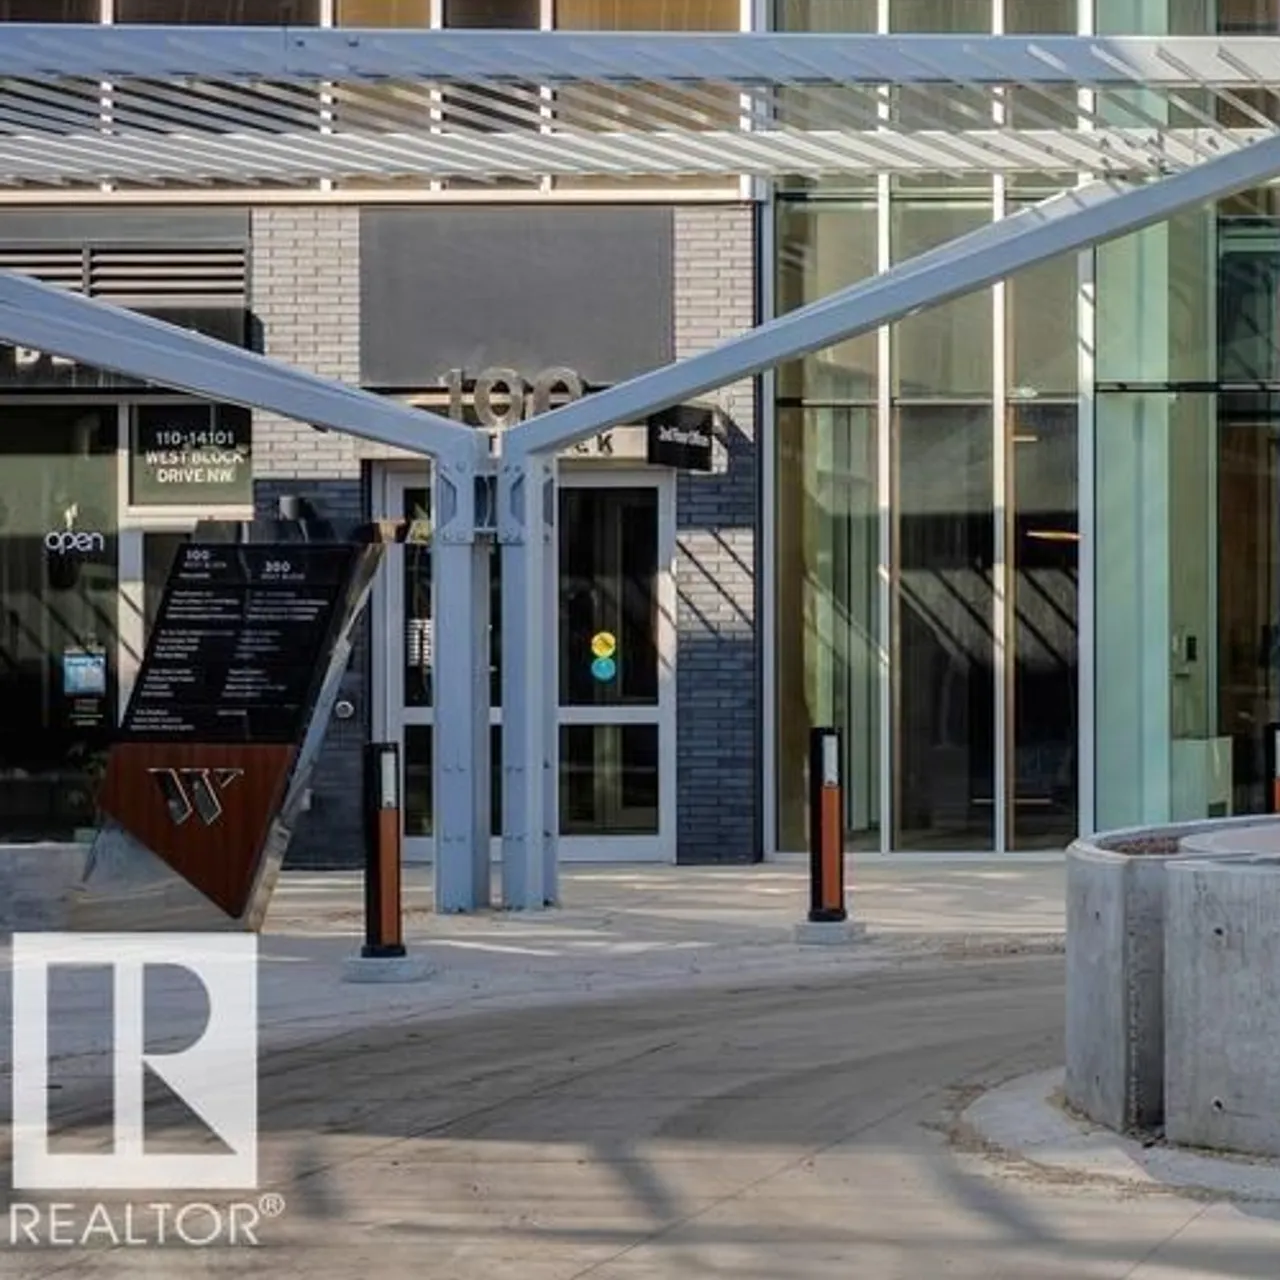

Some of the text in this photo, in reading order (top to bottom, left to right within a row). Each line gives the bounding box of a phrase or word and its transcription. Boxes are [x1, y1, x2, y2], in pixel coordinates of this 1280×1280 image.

[146, 448, 244, 464] WEST BLOCK
[157, 468, 236, 483] DRIVE NW
[45, 531, 104, 555] open
